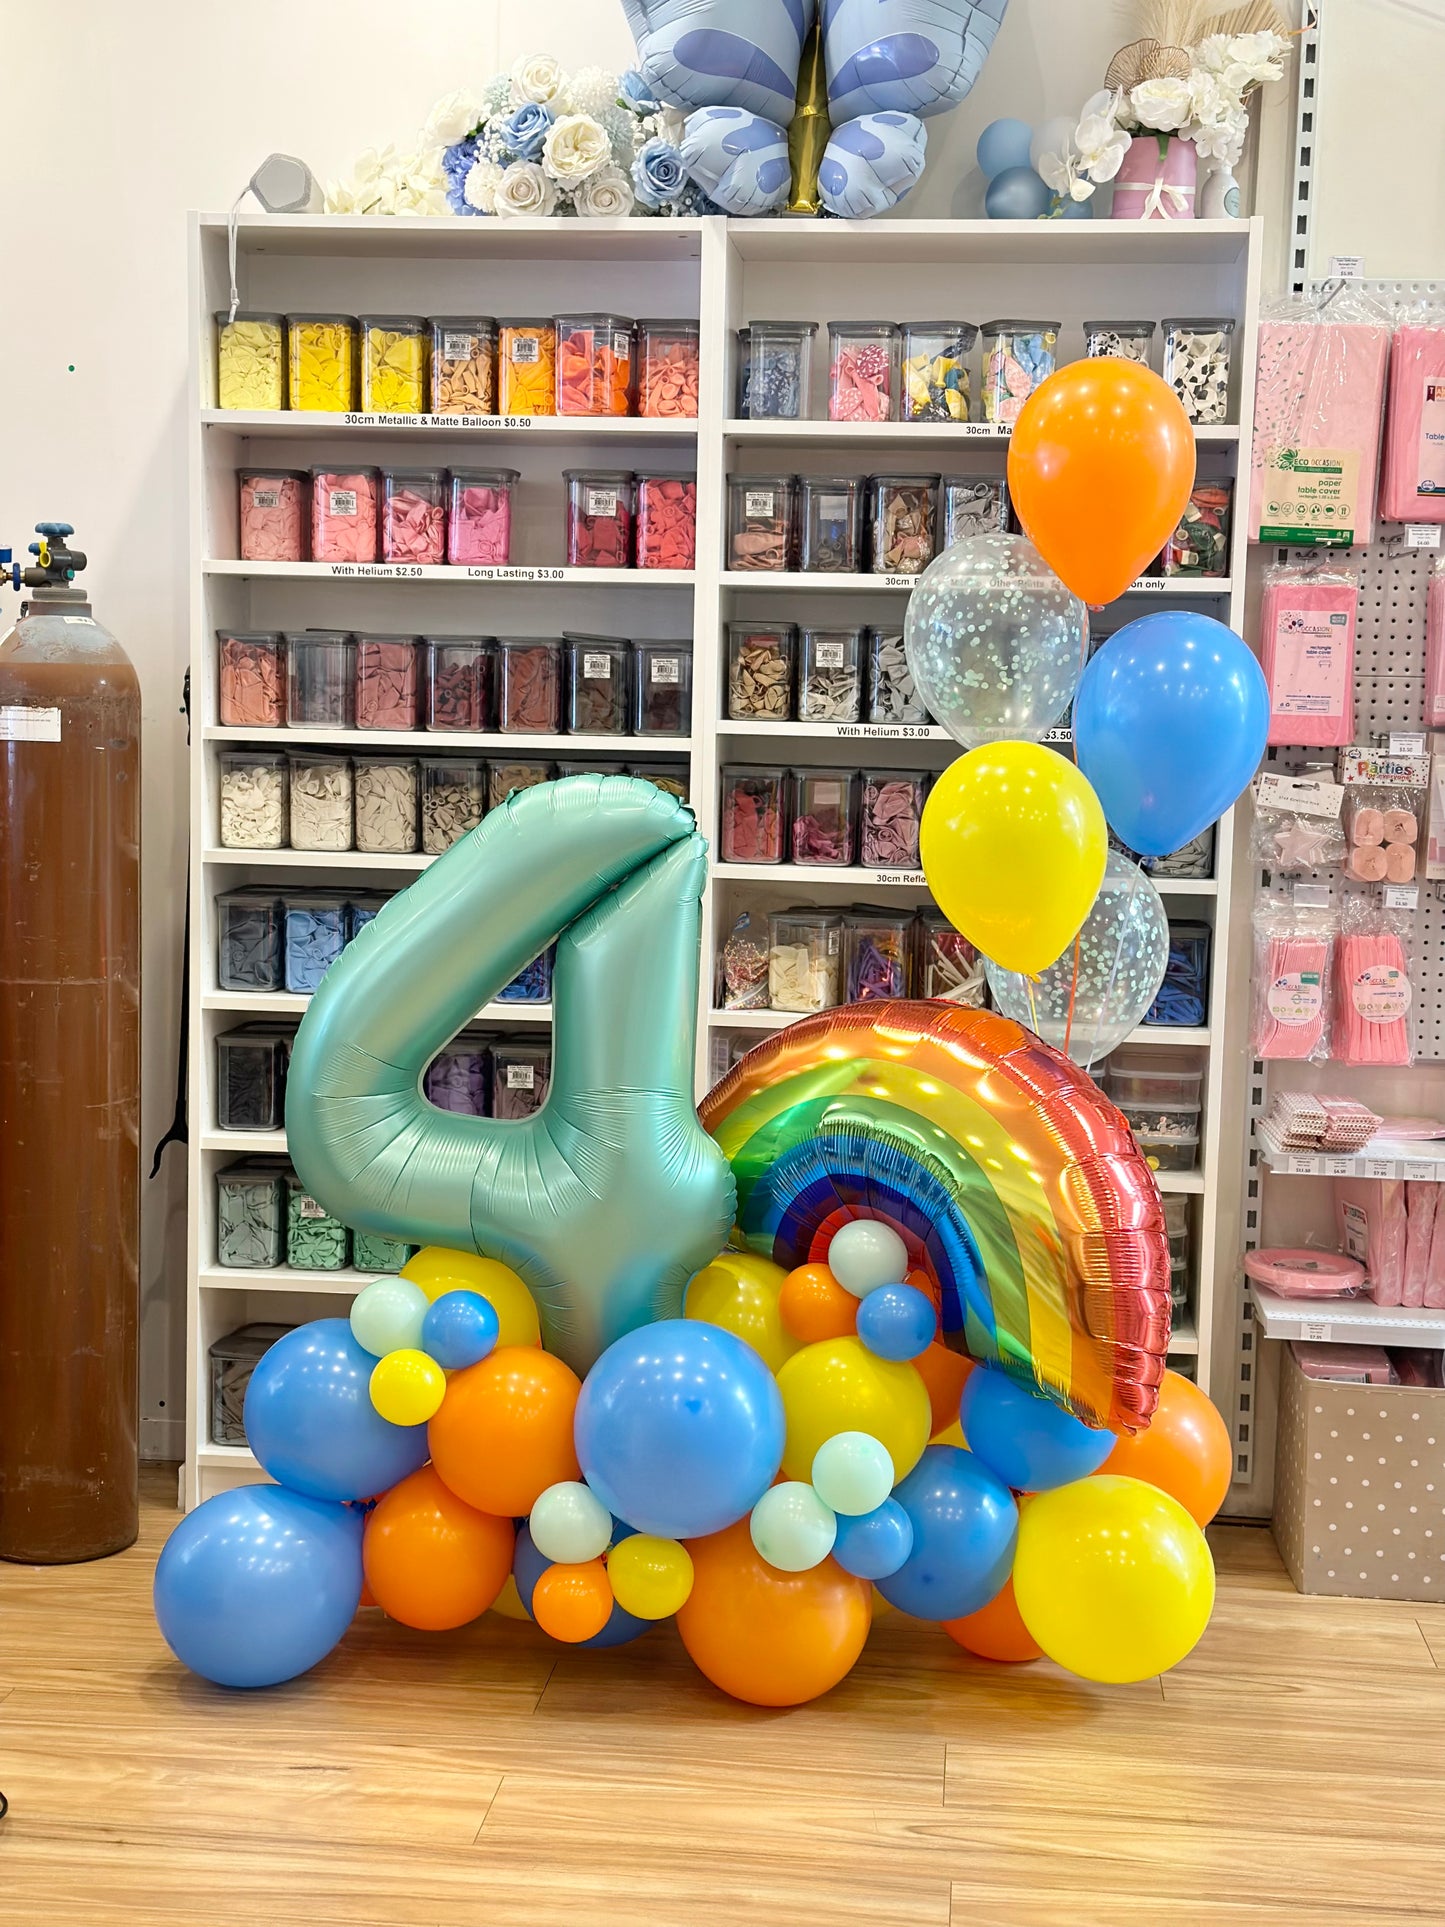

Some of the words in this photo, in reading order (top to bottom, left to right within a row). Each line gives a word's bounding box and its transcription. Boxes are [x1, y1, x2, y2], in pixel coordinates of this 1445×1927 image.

[344, 414, 375, 425] 30cm
[378, 415, 418, 426] Metallic
[420, 416, 428, 426] &
[431, 416, 459, 426] Matte
[462, 417, 501, 427] Balloon
[504, 417, 532, 427] $0.50
[966, 425, 991, 435] 30cm
[997, 425, 1013, 435] Ma
[1318, 479, 1342, 487] paper
[1297, 486, 1317, 494] table
[1318, 487, 1341, 495] cover
[331, 566, 355, 576] With
[357, 566, 393, 576] Helium
[395, 567, 423, 577] $2.50
[467, 568, 494, 579] Long
[497, 568, 535, 580] Lasting
[537, 569, 564, 579] $3.00
[885, 577, 910, 586] 30cm
[1145, 580, 1166, 590] only
[837, 726, 861, 736] With
[863, 727, 900, 737] Helium
[902, 727, 930, 738] $3.00
[1357, 760, 1414, 776] Parties
[876, 874, 901, 883] 30cm
[903, 874, 926, 883] Refle
